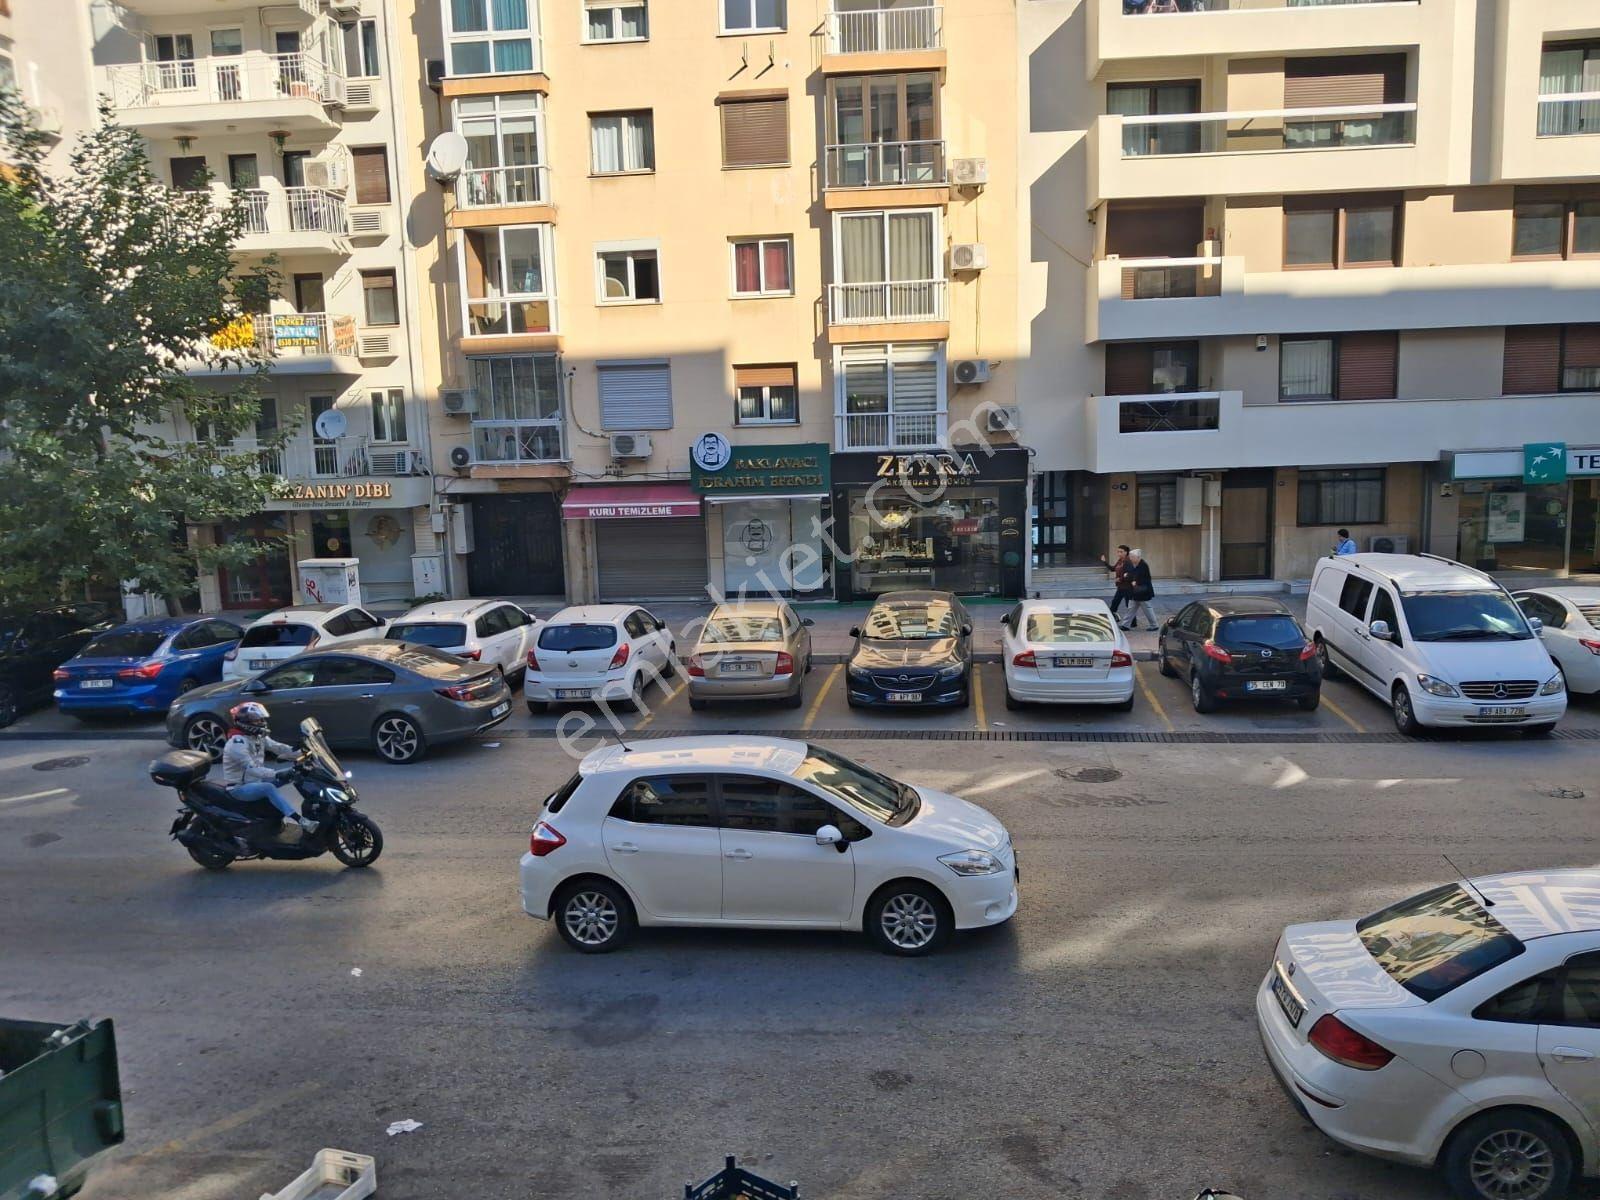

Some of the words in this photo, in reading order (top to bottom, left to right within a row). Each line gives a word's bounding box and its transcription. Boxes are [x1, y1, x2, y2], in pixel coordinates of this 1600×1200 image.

[277, 328, 316, 337] SATILIK
[877, 453, 980, 476] ZEYRA
[355, 481, 392, 499] DİBİ
[588, 507, 616, 516] KURU
